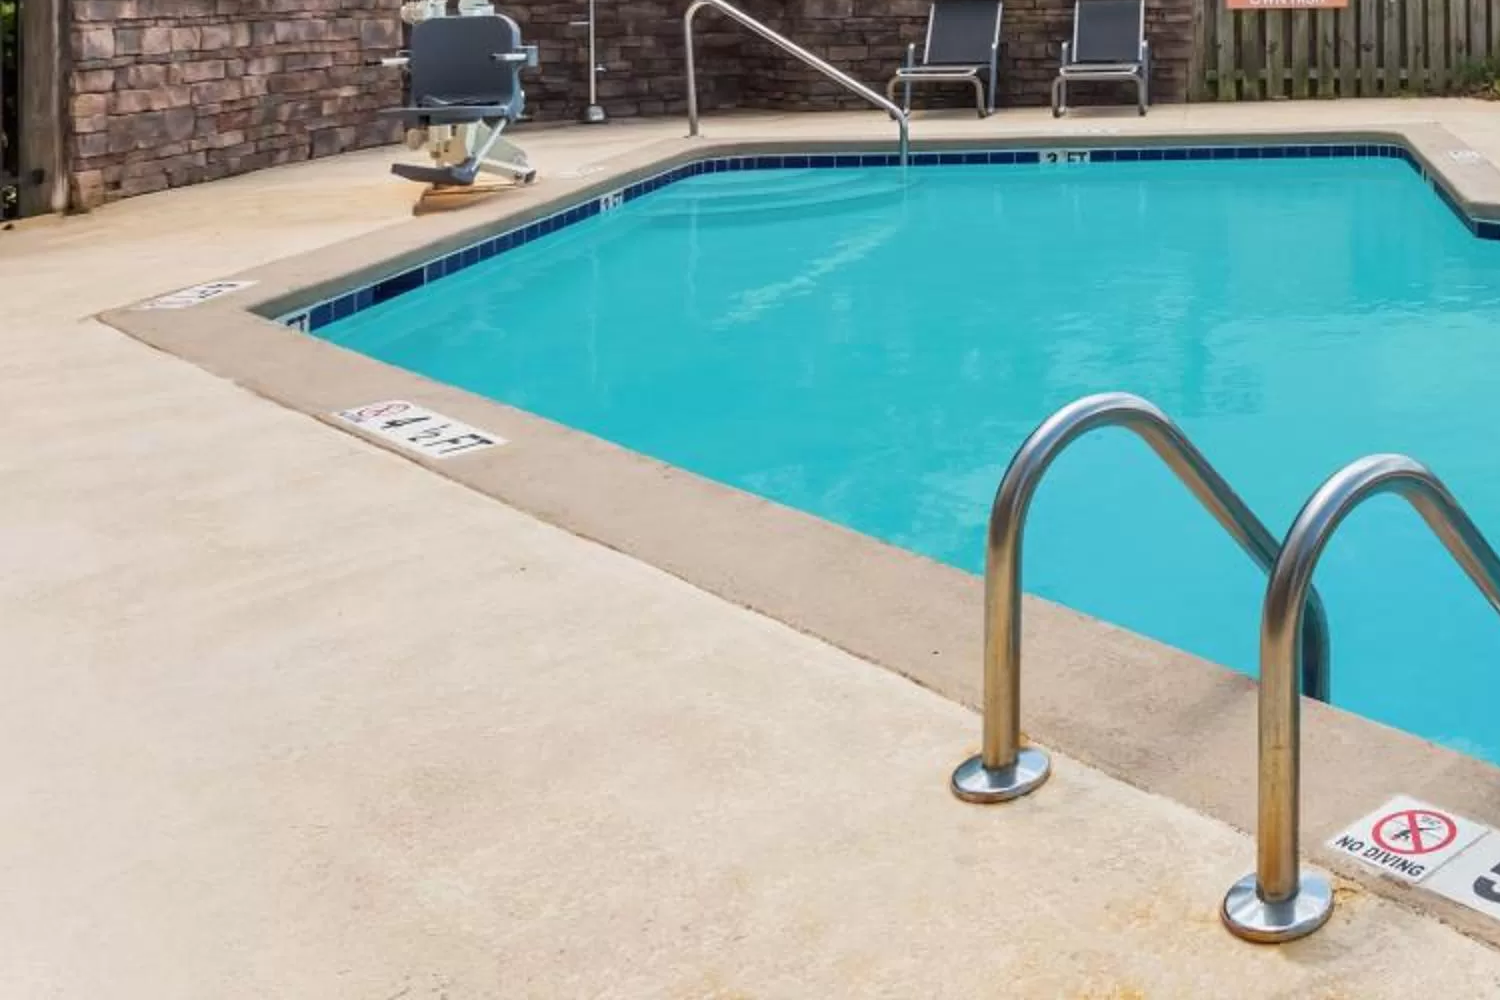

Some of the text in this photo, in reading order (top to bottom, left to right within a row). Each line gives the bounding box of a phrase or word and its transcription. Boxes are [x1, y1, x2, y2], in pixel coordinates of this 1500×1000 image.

[423, 433, 495, 455] FT
[1335, 834, 1426, 878] NO DIVING
